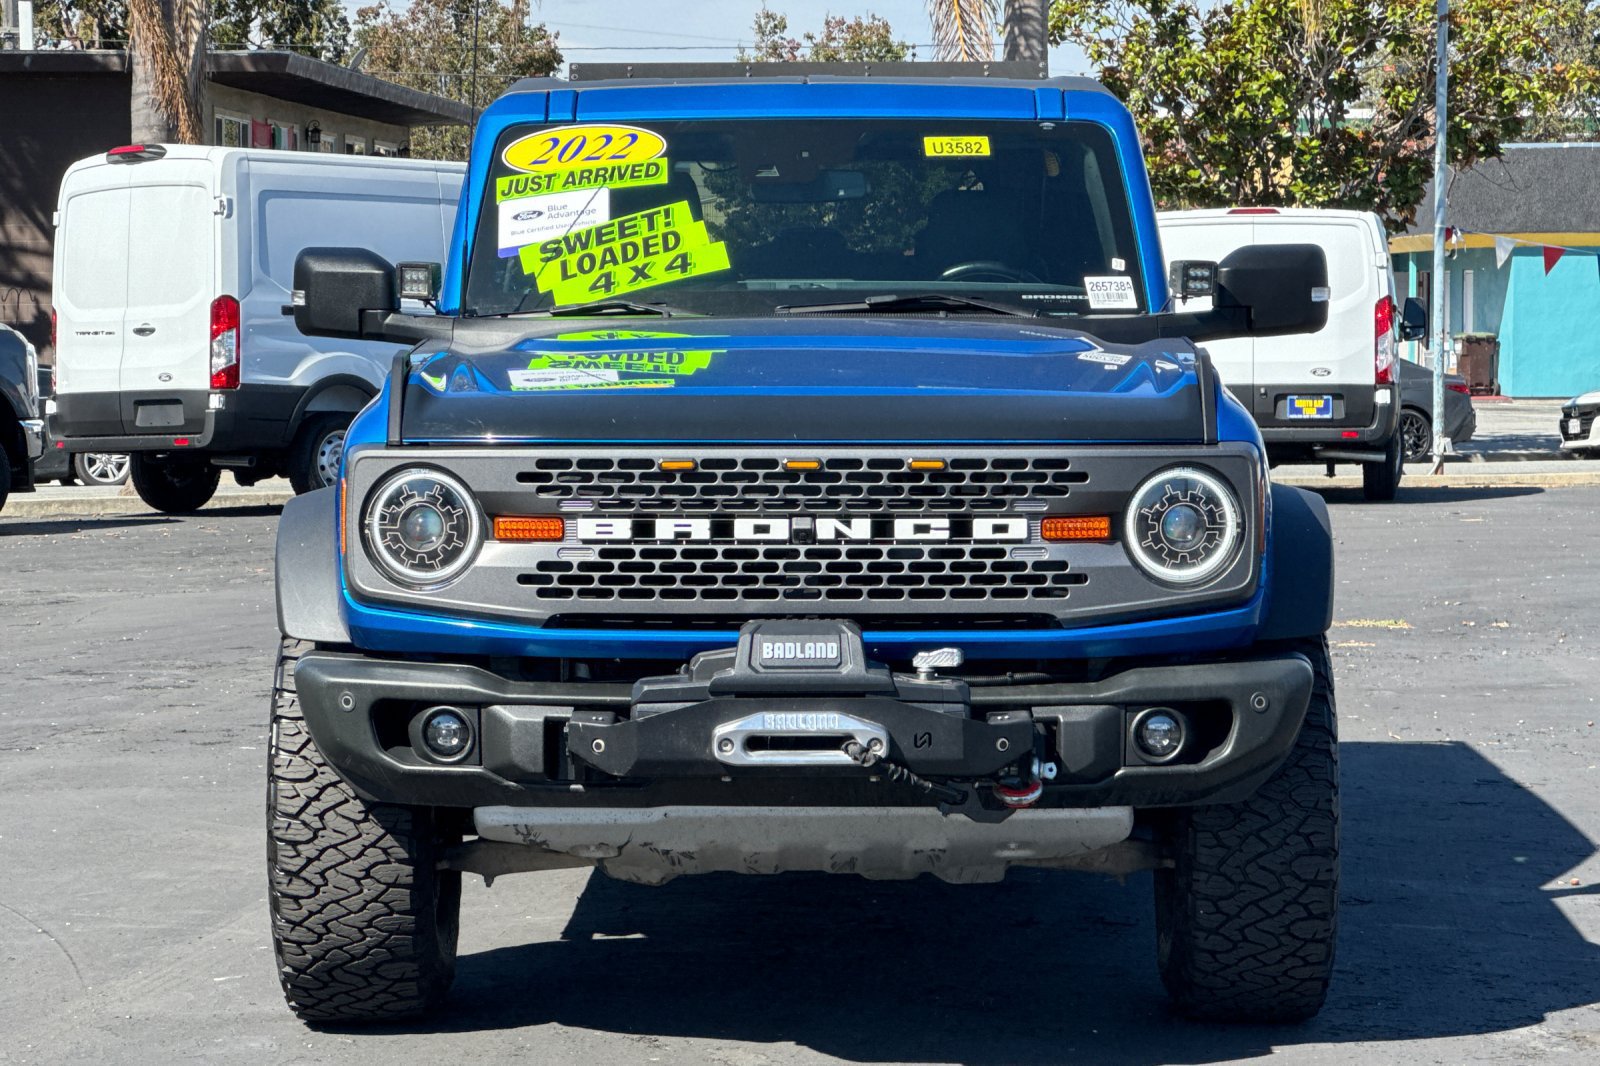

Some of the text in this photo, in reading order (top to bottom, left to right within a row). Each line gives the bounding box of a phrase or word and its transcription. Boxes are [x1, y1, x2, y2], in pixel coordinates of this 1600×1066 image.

[529, 133, 638, 166] 2022
[932, 141, 983, 155] U3582
[500, 161, 662, 198] JUST ARRIVED
[547, 203, 568, 212] Blue
[540, 207, 672, 263] SWEET!
[560, 231, 681, 282] LOADED
[588, 271, 616, 294] 4
[664, 252, 692, 274] 4
[1089, 281, 1133, 292] 265738A
[577, 518, 1028, 540] BRONCO
[762, 642, 838, 659] BADLAND
